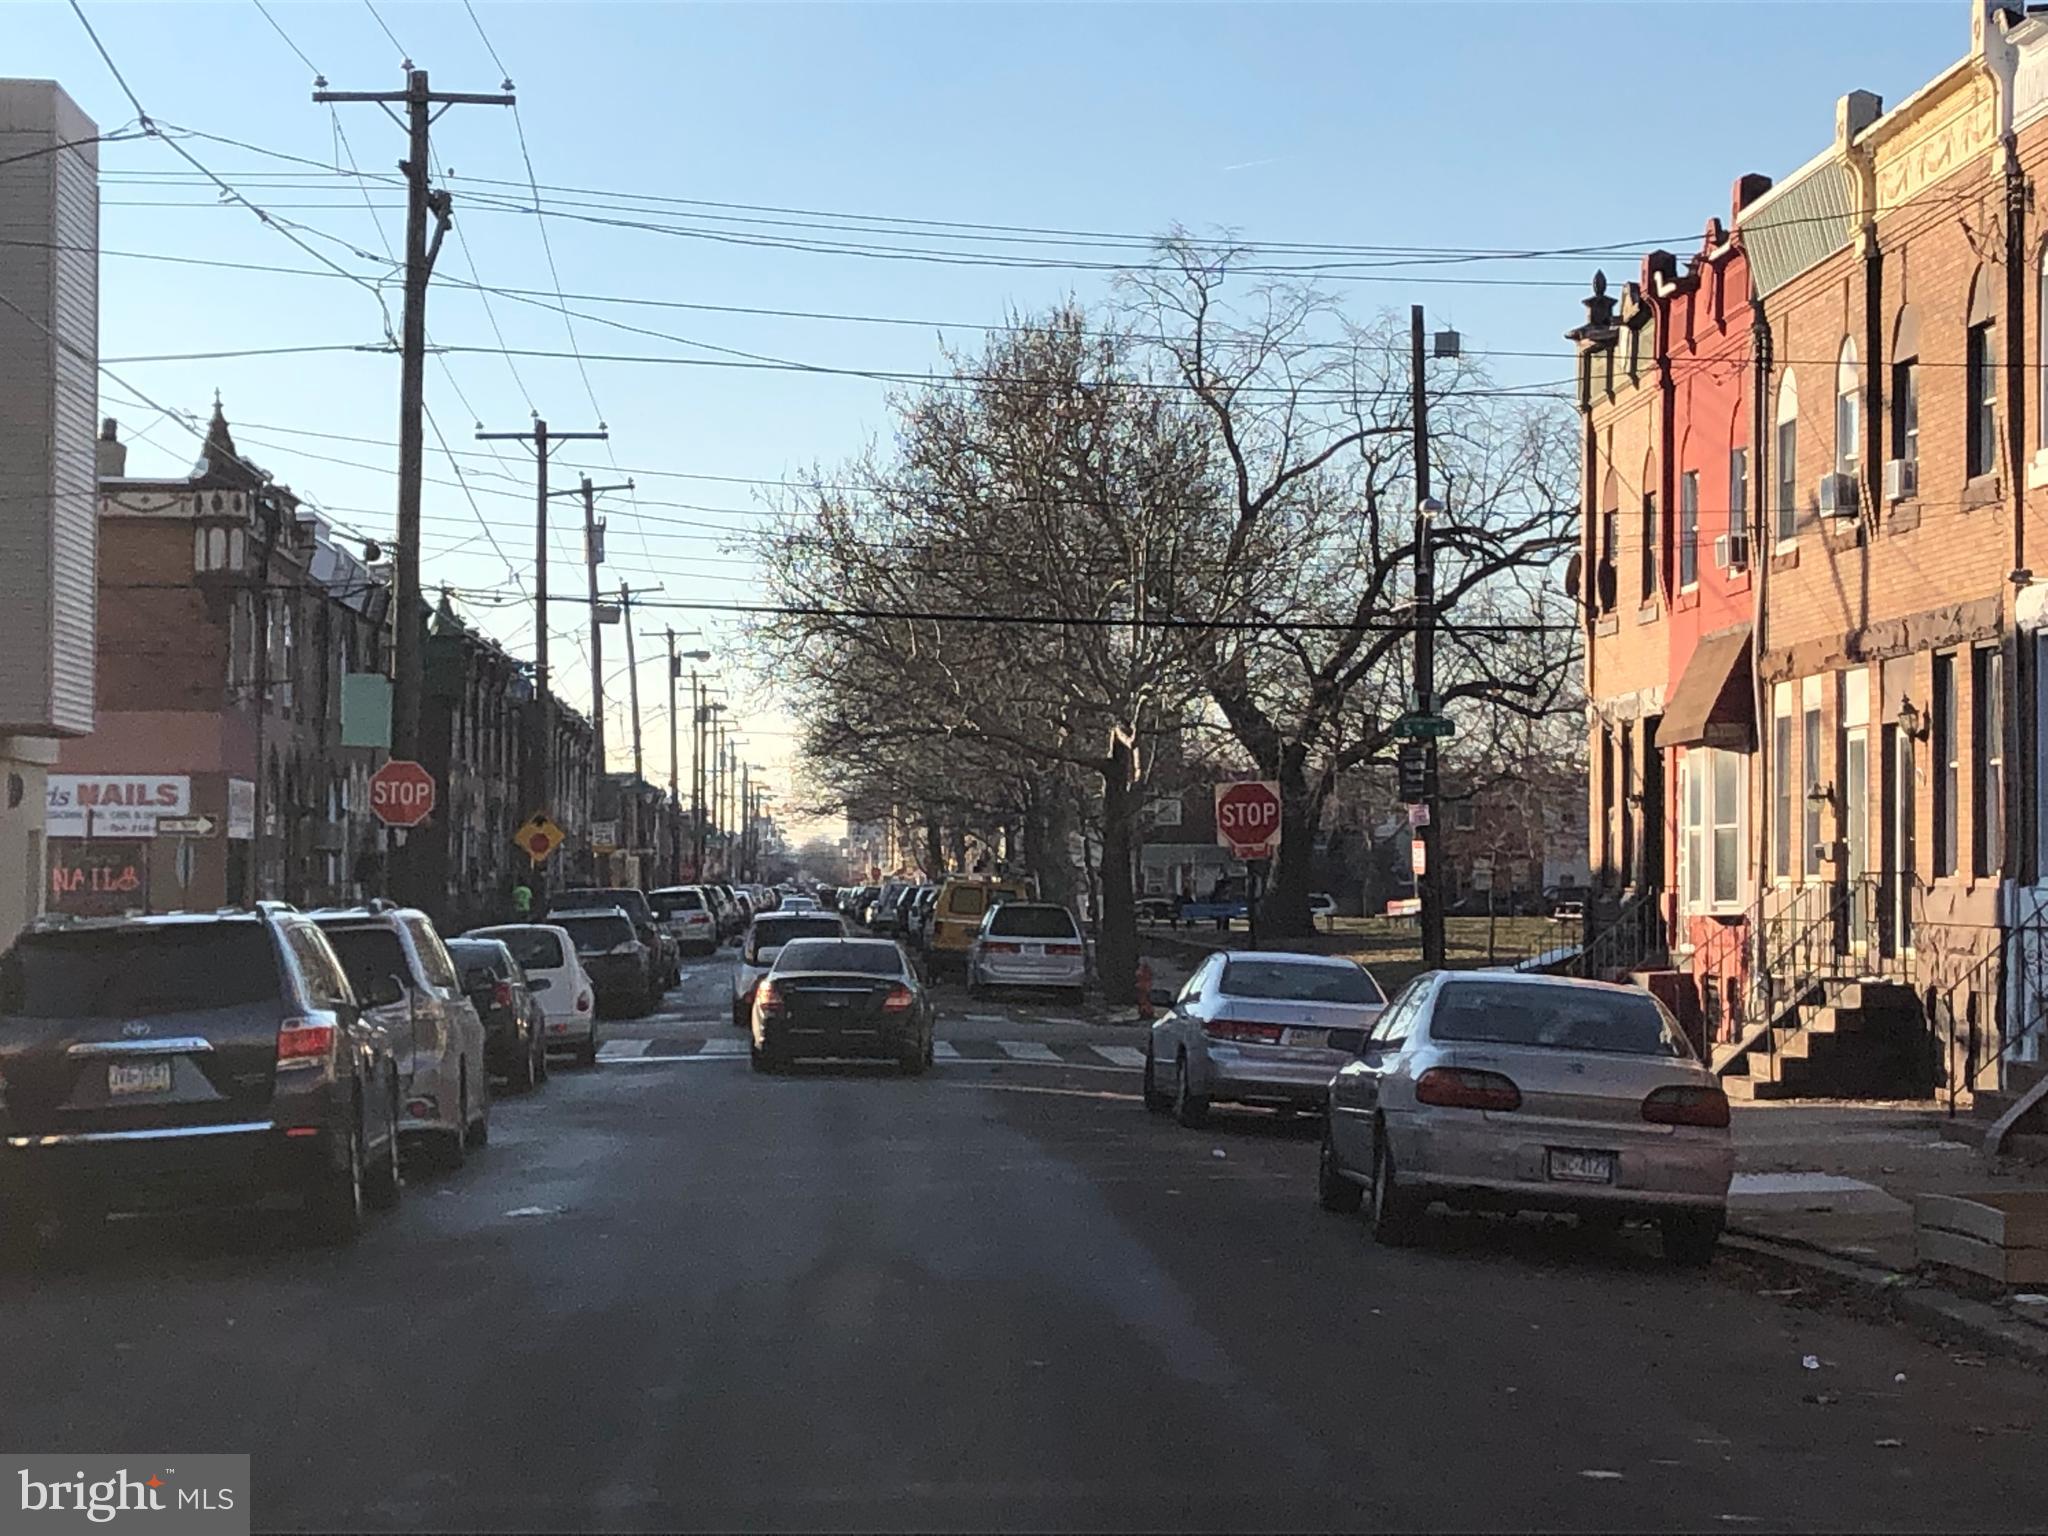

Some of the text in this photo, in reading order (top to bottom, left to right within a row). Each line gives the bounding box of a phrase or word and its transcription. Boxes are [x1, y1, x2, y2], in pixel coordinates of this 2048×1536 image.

[76, 783, 180, 807] NAILS
[374, 783, 431, 806] STOP
[1221, 801, 1277, 827] STOP
